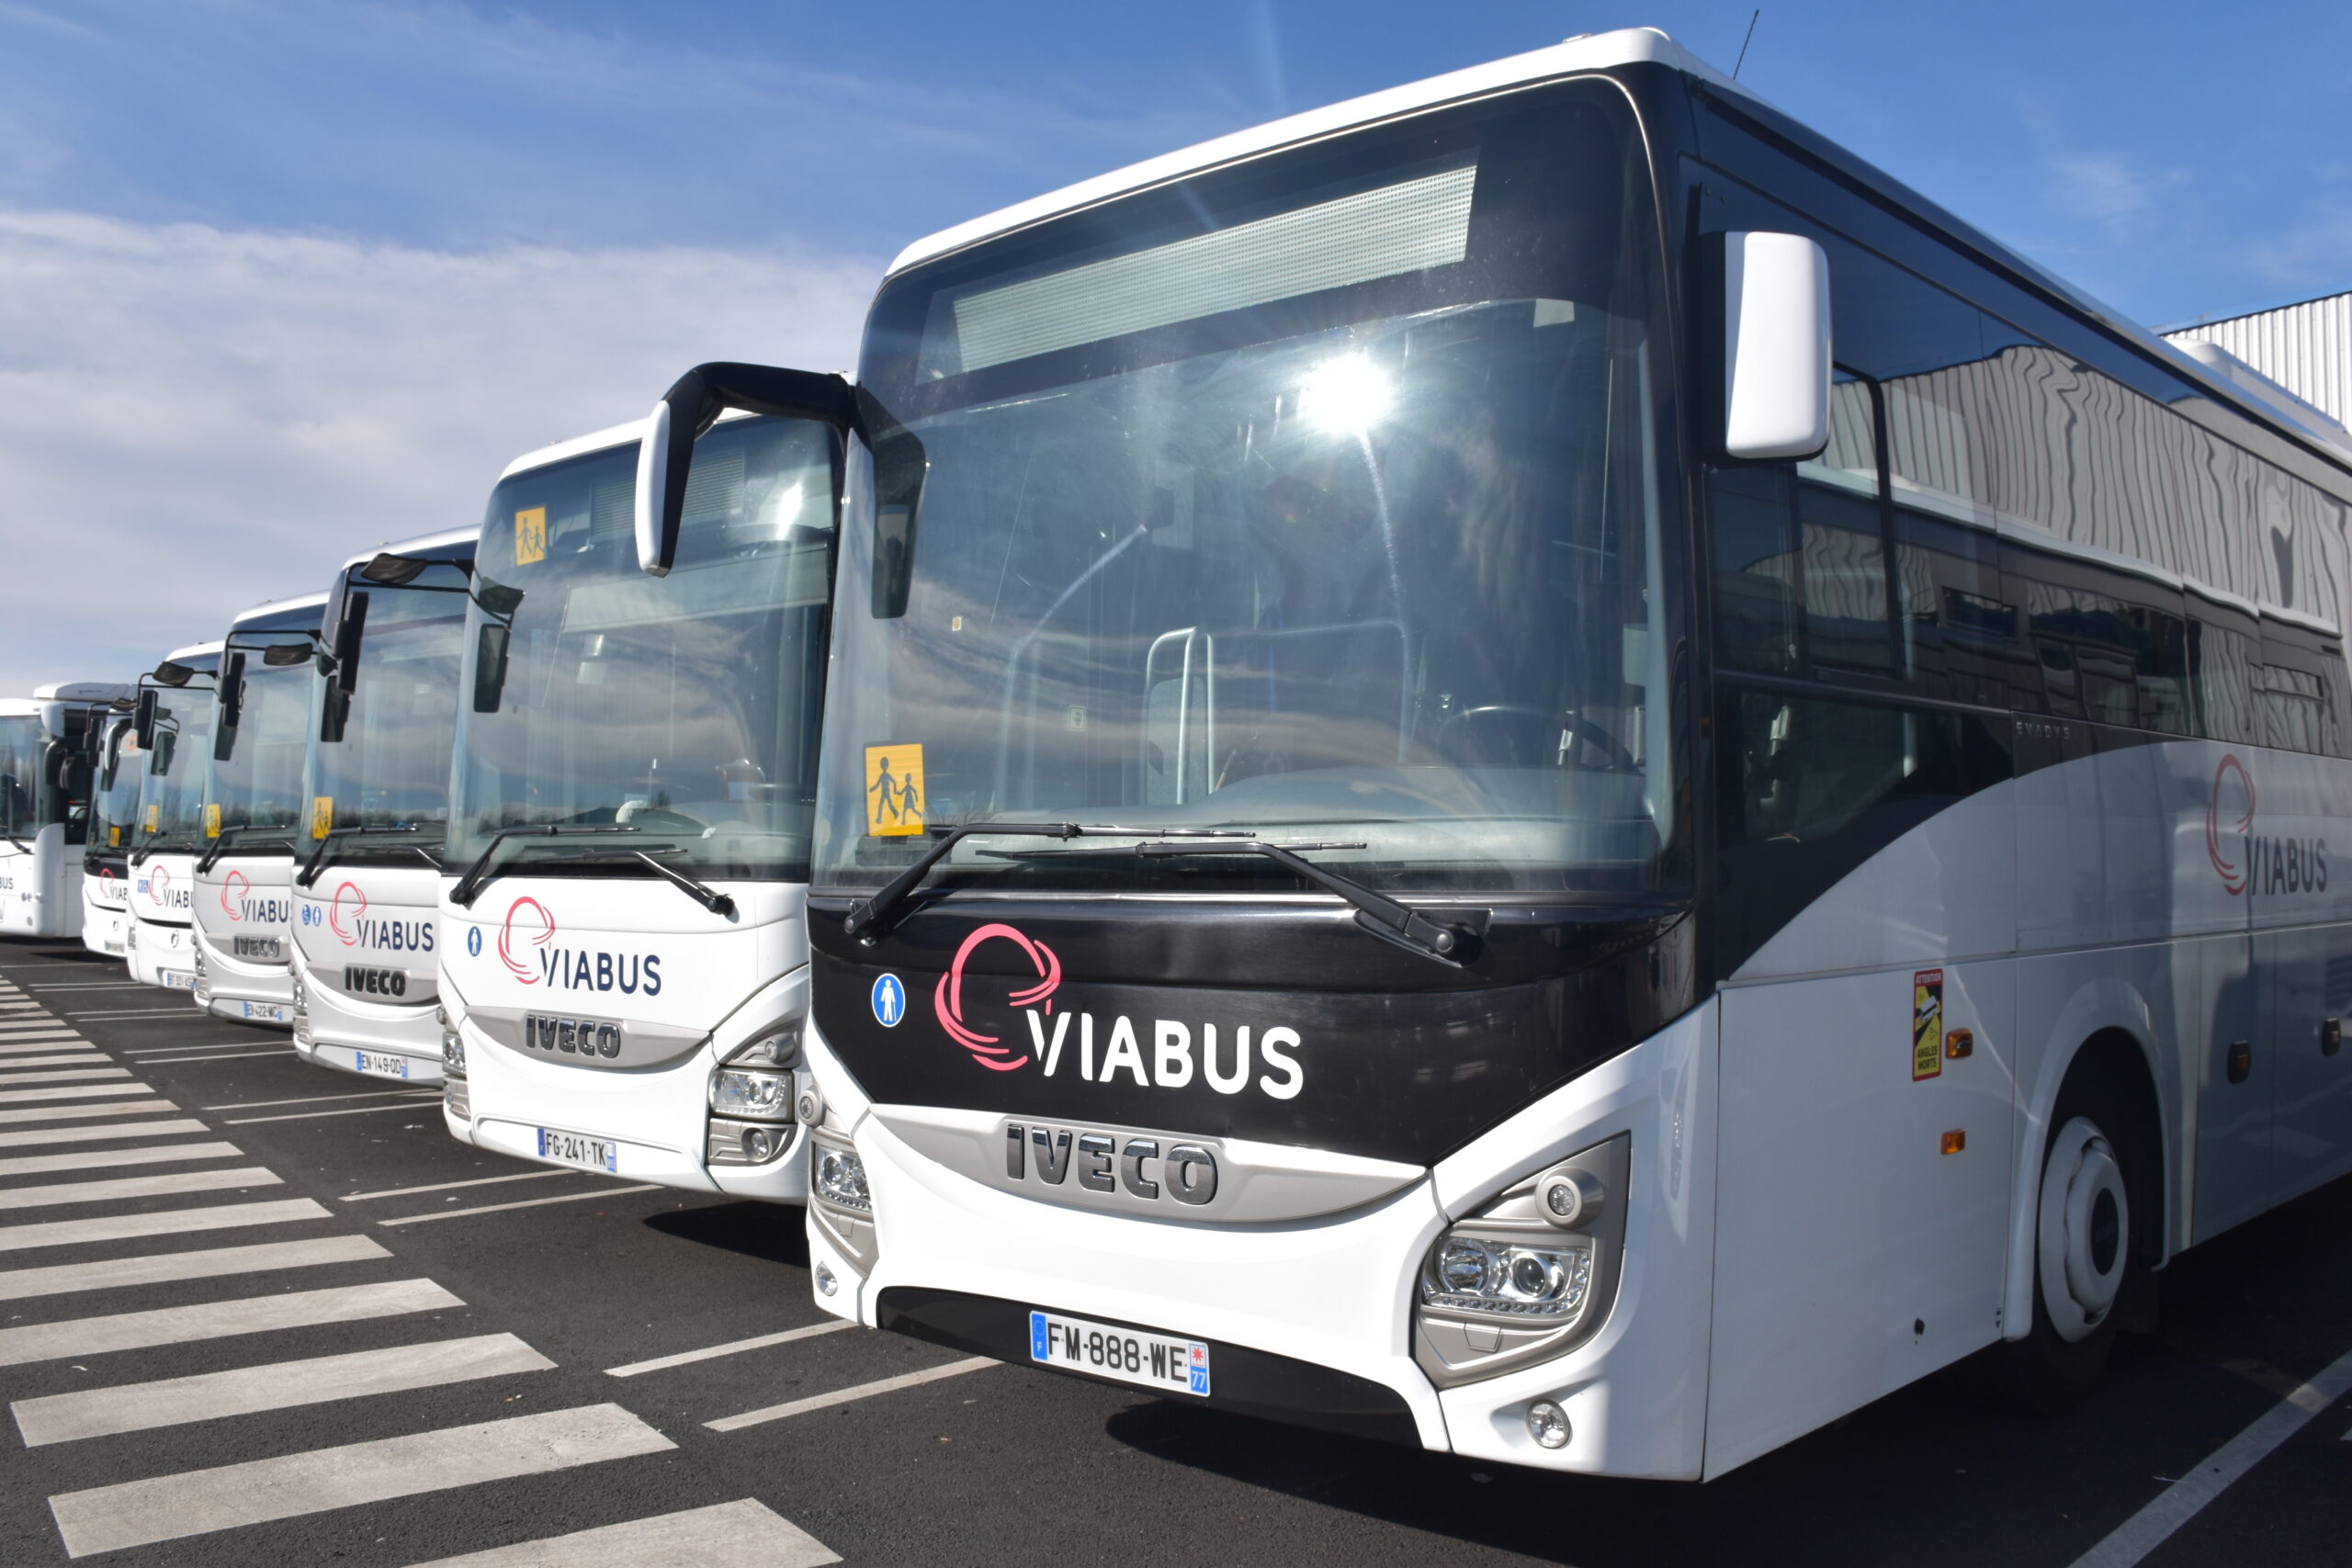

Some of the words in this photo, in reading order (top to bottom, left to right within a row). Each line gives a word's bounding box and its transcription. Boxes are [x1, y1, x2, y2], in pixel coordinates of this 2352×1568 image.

[2244, 835, 2328, 897] VIABUS
[241, 899, 291, 923] VIABU
[233, 936, 280, 958] IVECO
[356, 919, 435, 953] VIABUS
[345, 966, 406, 997] IVECO
[540, 947, 662, 997] VIABUS
[526, 1013, 622, 1059] IVECO
[1026, 1009, 1305, 1100] VIABUS
[546, 1133, 606, 1167] FG-241-TK
[1005, 1122, 1220, 1206] IVECO
[1047, 1322, 1188, 1383] FM-888-WE
[1192, 1370, 1206, 1389] 77
